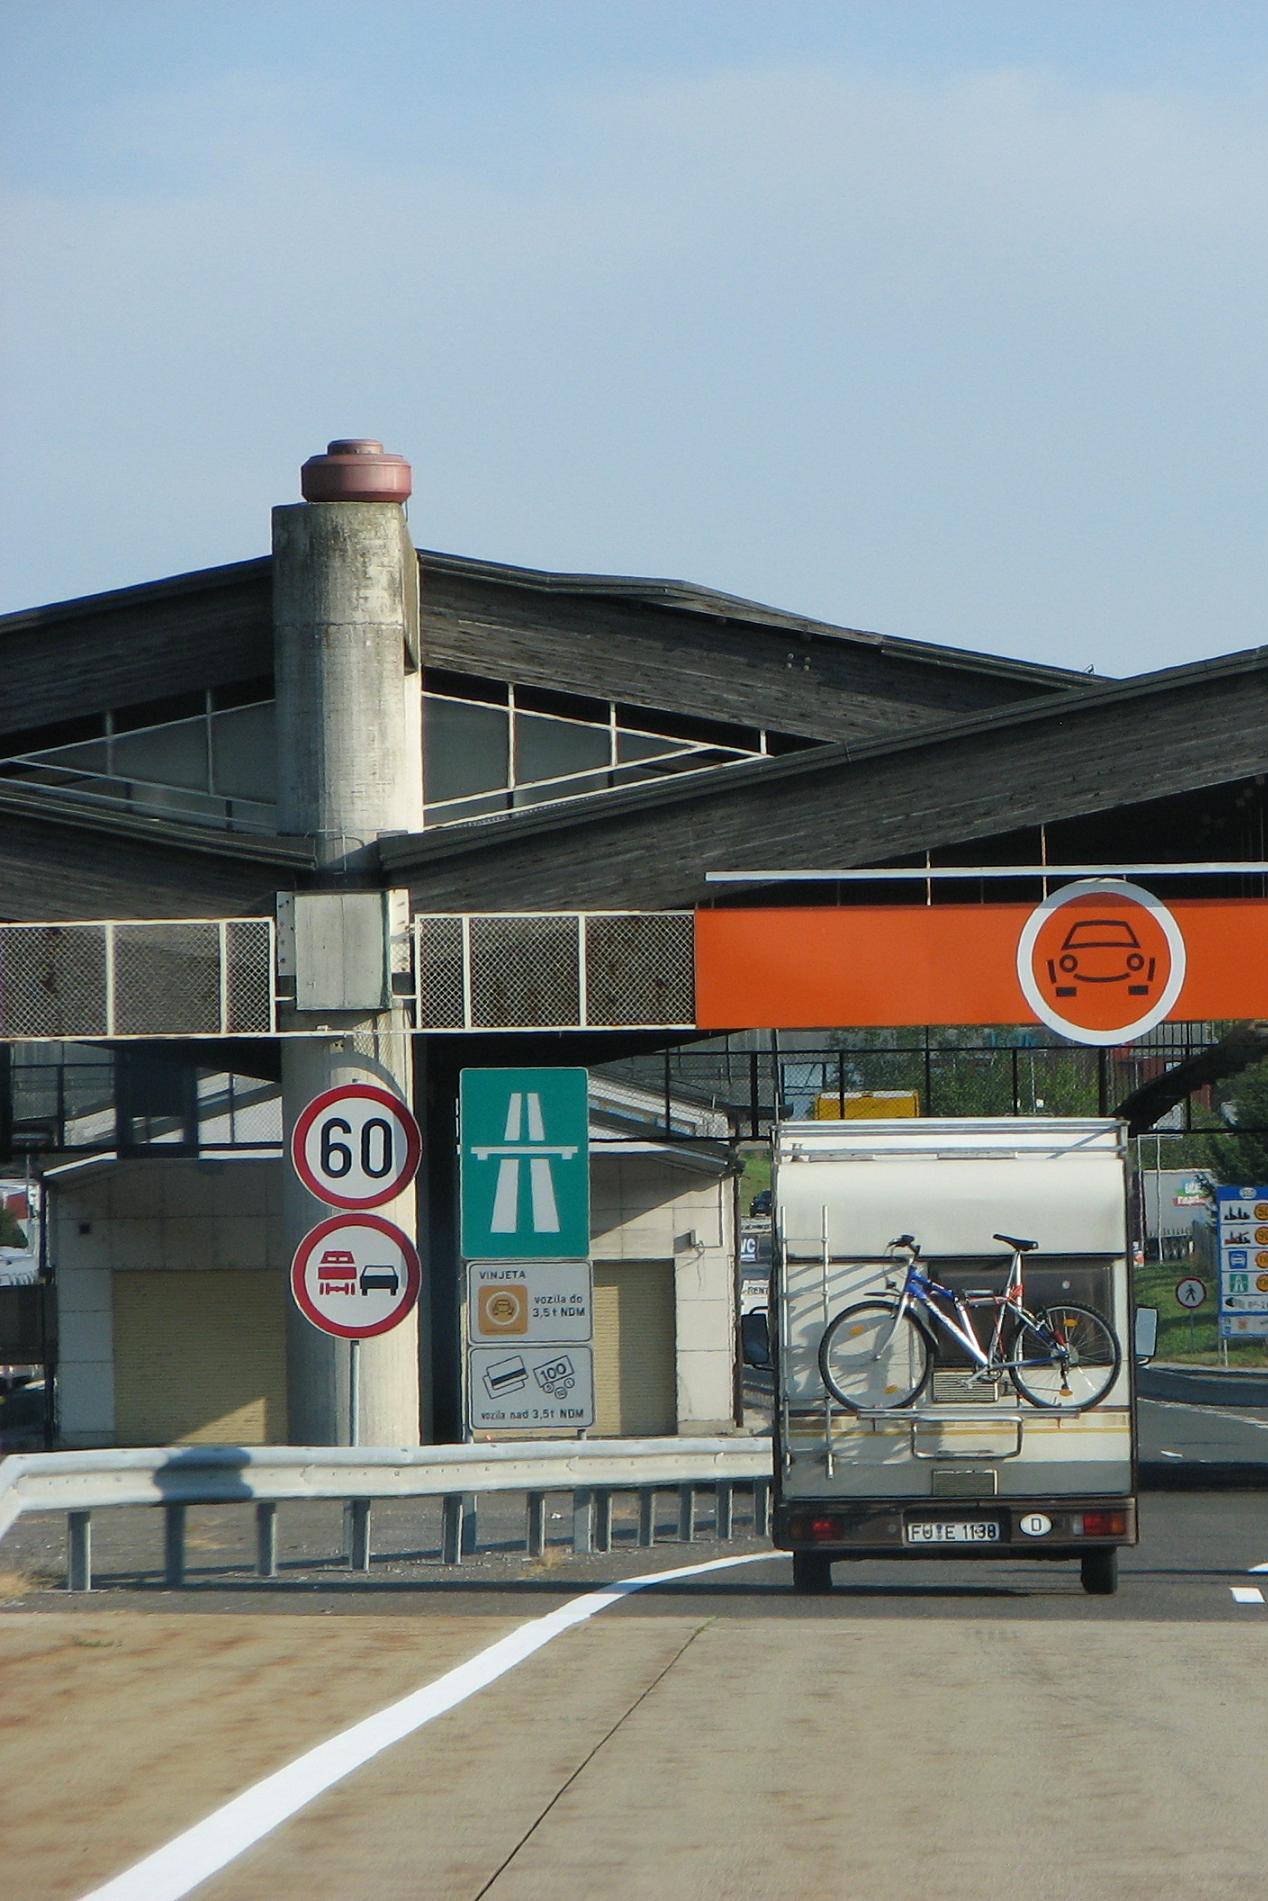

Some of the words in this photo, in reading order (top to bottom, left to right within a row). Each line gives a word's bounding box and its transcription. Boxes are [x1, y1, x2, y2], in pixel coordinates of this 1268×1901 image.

[320, 1117, 393, 1179] 60
[479, 1270, 526, 1280] VINJETA
[533, 1294, 567, 1305] vozila
[570, 1295, 583, 1304] do
[561, 1307, 586, 1317] NDM
[540, 1363, 567, 1382] 100
[480, 1410, 506, 1420] vozila
[509, 1409, 529, 1420] nad
[559, 1408, 584, 1418] NDM
[1030, 1517, 1043, 1532] D
[945, 1524, 956, 1540] E
